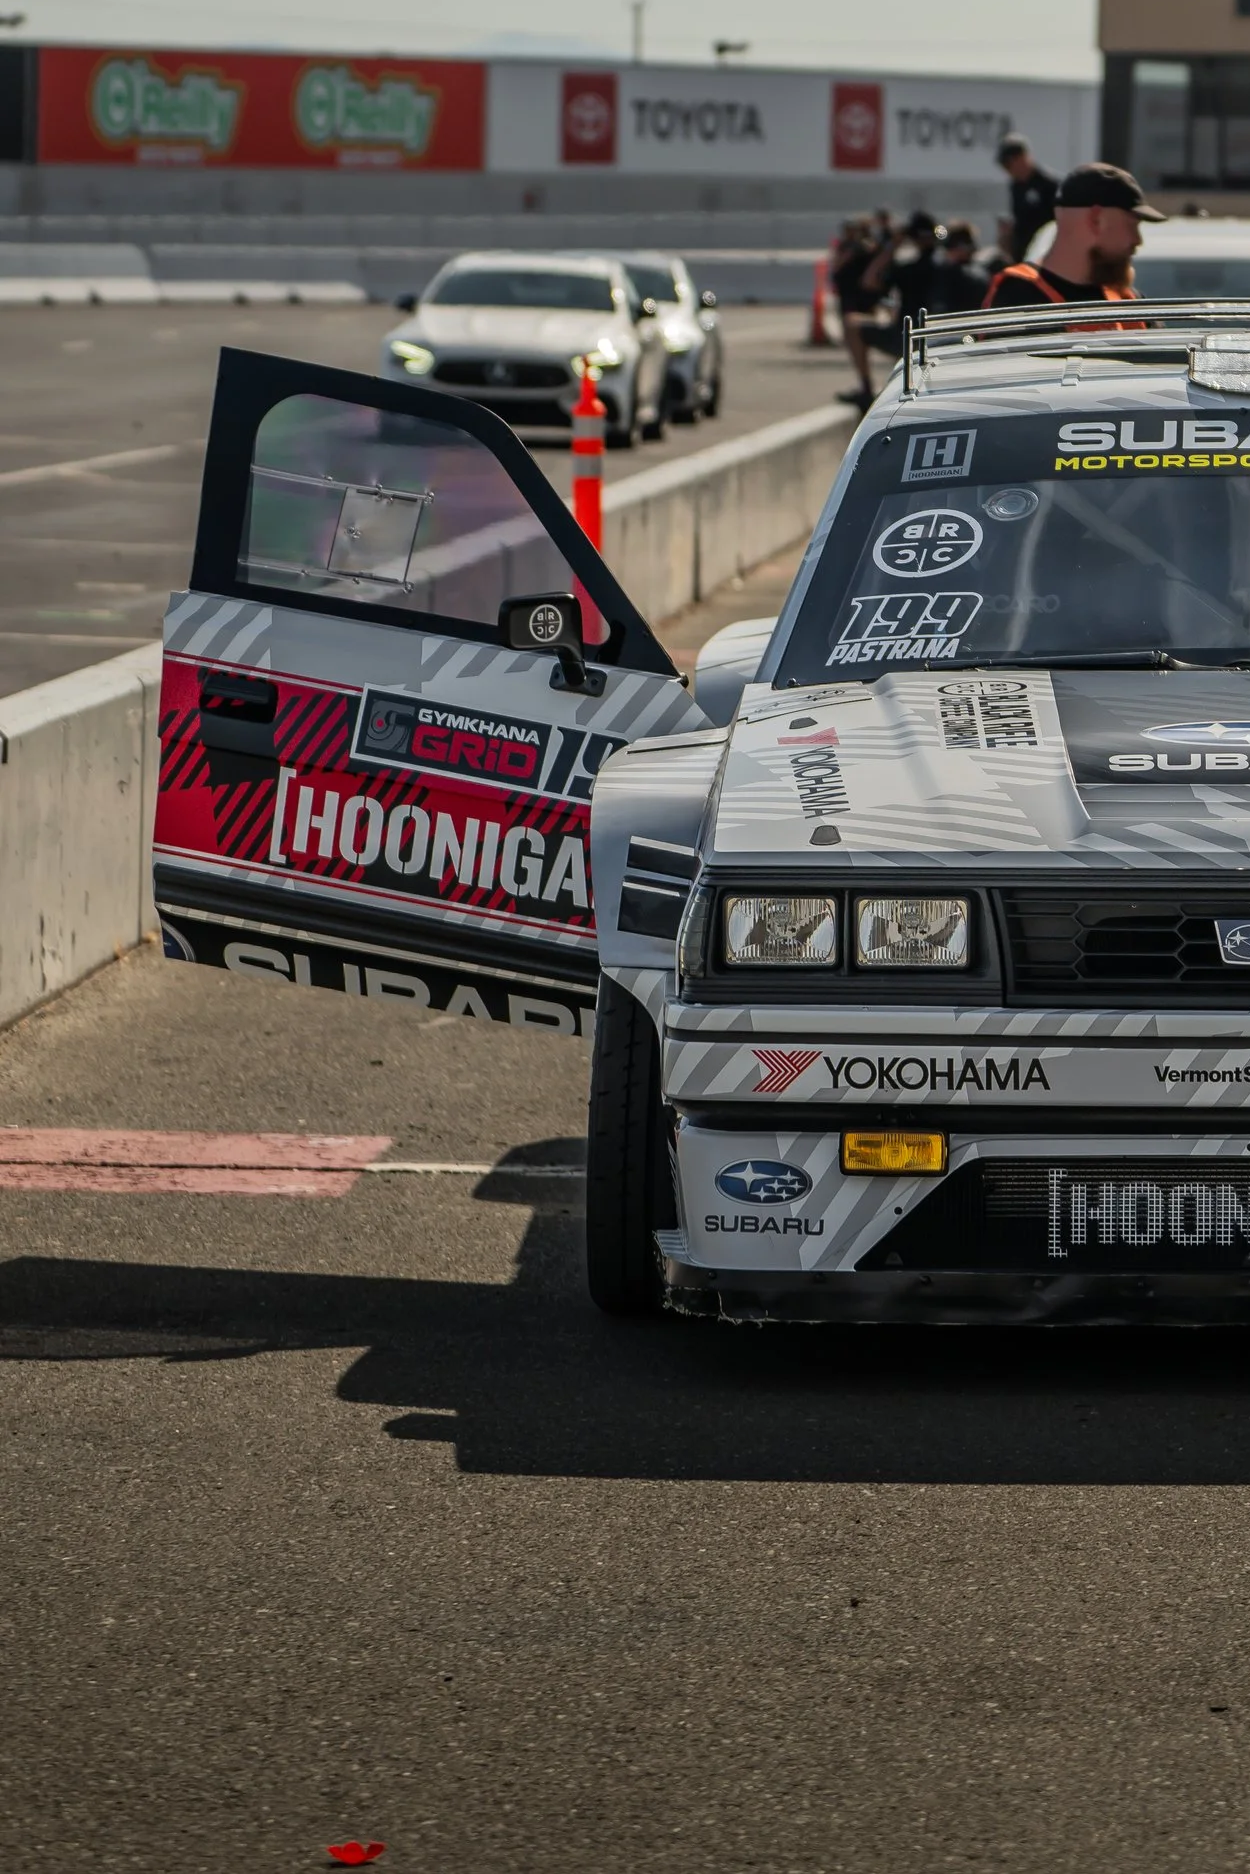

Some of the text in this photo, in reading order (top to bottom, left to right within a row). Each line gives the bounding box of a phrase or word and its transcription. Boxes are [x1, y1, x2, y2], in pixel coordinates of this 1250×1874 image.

[631, 99, 764, 142] TOYOTA
[838, 592, 983, 644] 199
[825, 638, 961, 667] PASTRANA
[418, 708, 541, 746] GYMKHANA
[788, 745, 851, 819] YOKOHAMA
[823, 1056, 1051, 1090] YOKOHAMA
[704, 1215, 824, 1236] SUBARU
